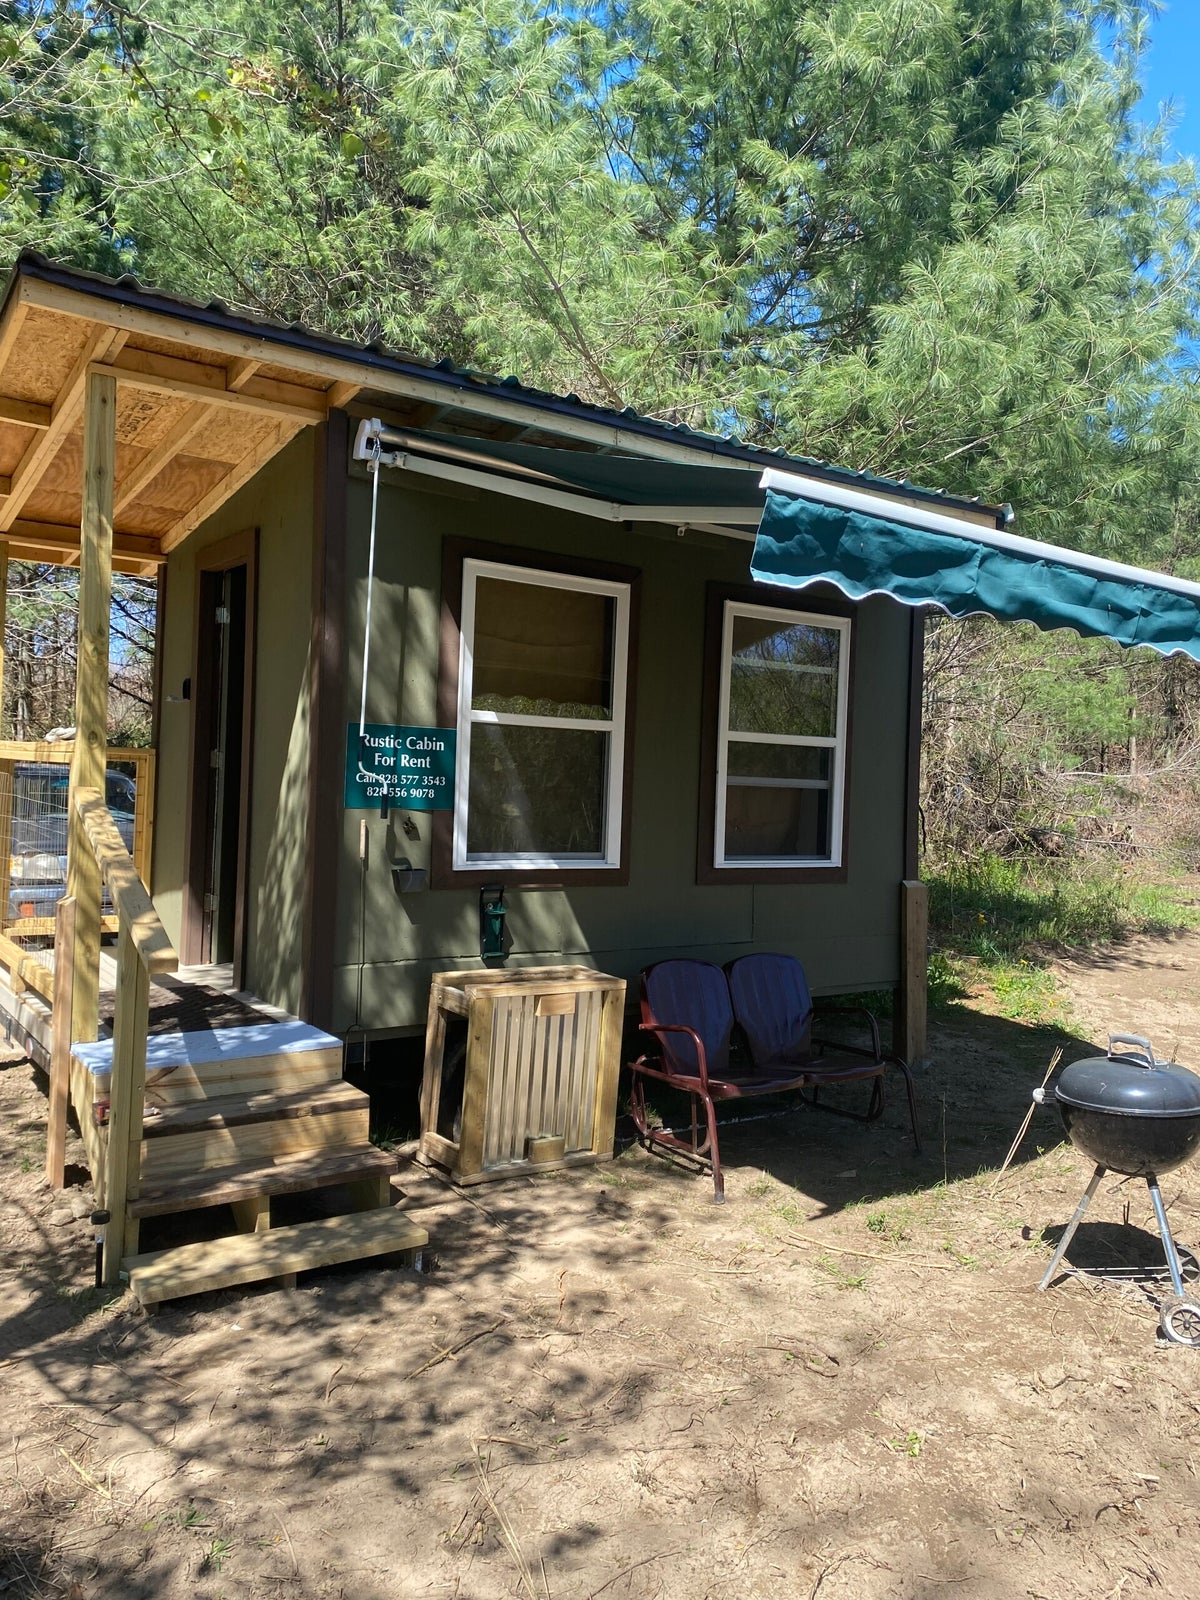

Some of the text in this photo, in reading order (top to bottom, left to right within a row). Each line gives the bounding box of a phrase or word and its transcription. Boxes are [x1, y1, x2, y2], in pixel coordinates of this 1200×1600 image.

[363, 733, 445, 751] Rustic Cabin
[374, 752, 431, 768] For Rent
[379, 773, 398, 784] 828
[400, 775, 420, 785] 577
[421, 776, 446, 786] 3543
[388, 787, 408, 797] 556
[410, 788, 435, 799] 9078
